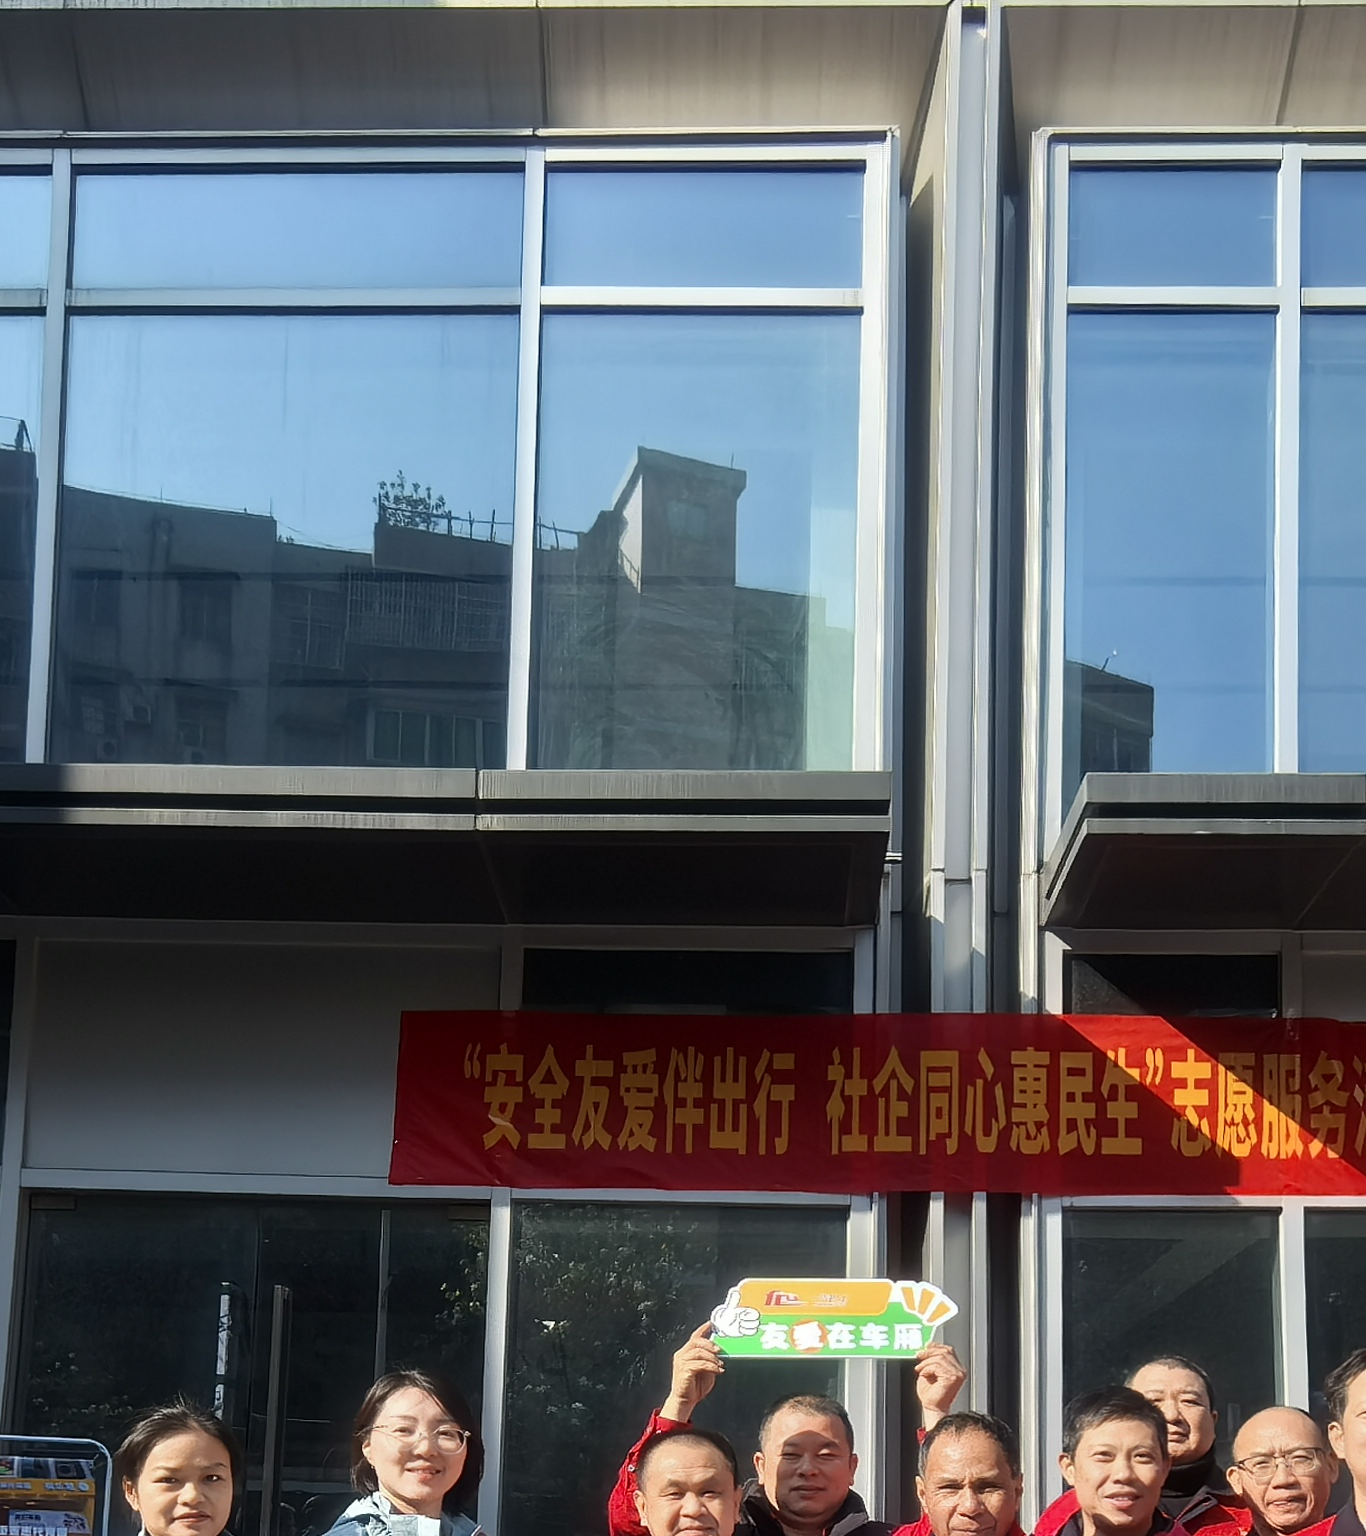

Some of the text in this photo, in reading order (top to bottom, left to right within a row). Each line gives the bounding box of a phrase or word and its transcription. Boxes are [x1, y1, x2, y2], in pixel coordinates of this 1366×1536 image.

[462, 1043, 795, 1156] “安全友爱伴出行
[759, 1320, 924, 1351] 友爱在车厢
